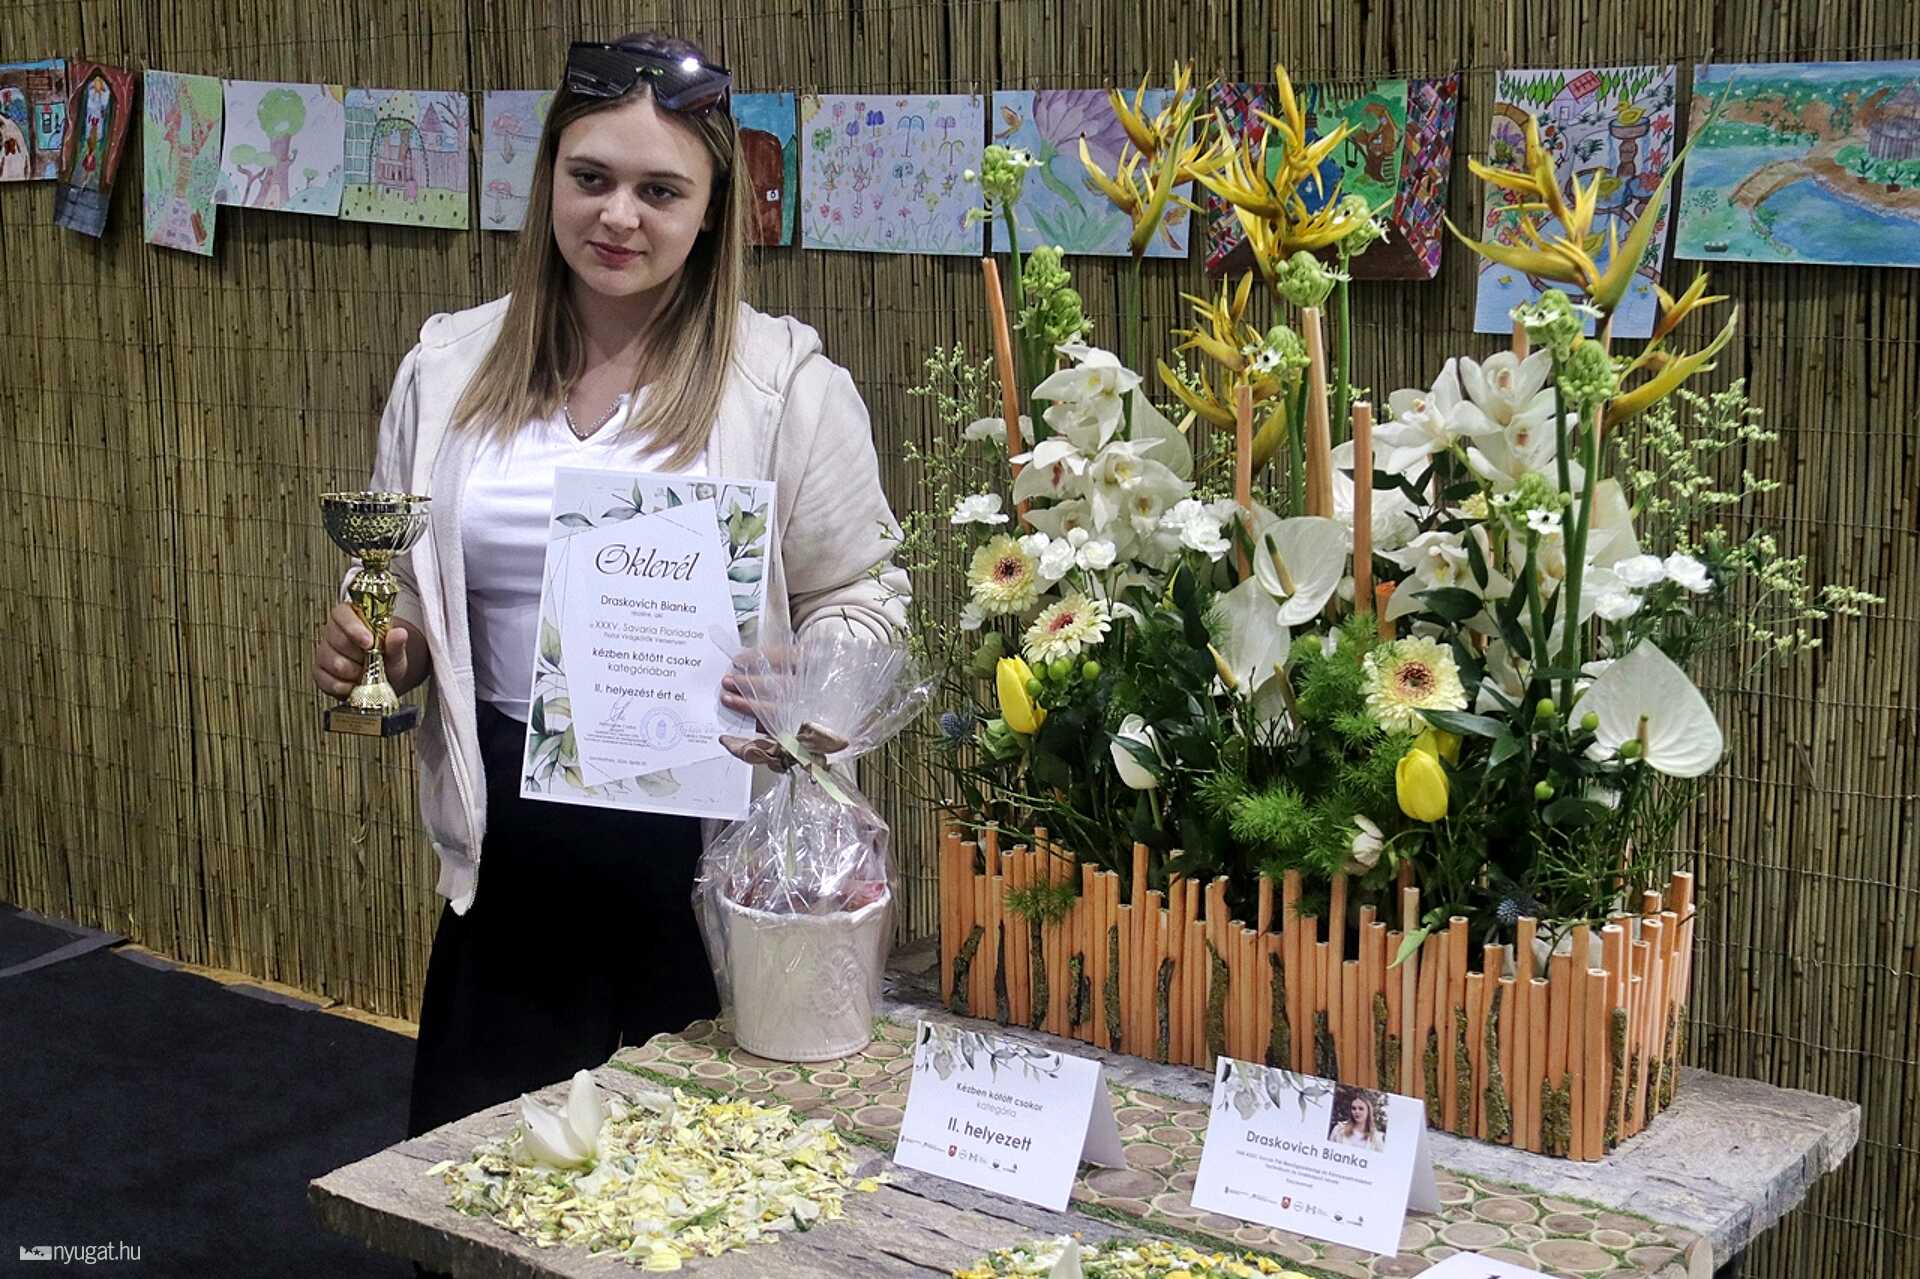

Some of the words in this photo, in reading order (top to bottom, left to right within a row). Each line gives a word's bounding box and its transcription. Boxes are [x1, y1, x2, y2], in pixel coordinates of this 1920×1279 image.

[595, 543, 700, 581] Oklevél
[601, 594, 658, 610] Draskovich
[660, 600, 697, 614] Bianka
[592, 647, 630, 660] kézben
[632, 650, 664, 663] kötött
[666, 656, 702, 668] csokor
[608, 662, 677, 678] kategóriában
[605, 684, 654, 699] helyezést
[656, 689, 672, 701] ért
[1014, 1098, 1044, 1112] csokor
[947, 1116, 960, 1134] II.
[964, 1120, 1032, 1152] helyezett
[1246, 1130, 1319, 1159] Draskovich
[1322, 1147, 1369, 1169] Bianka
